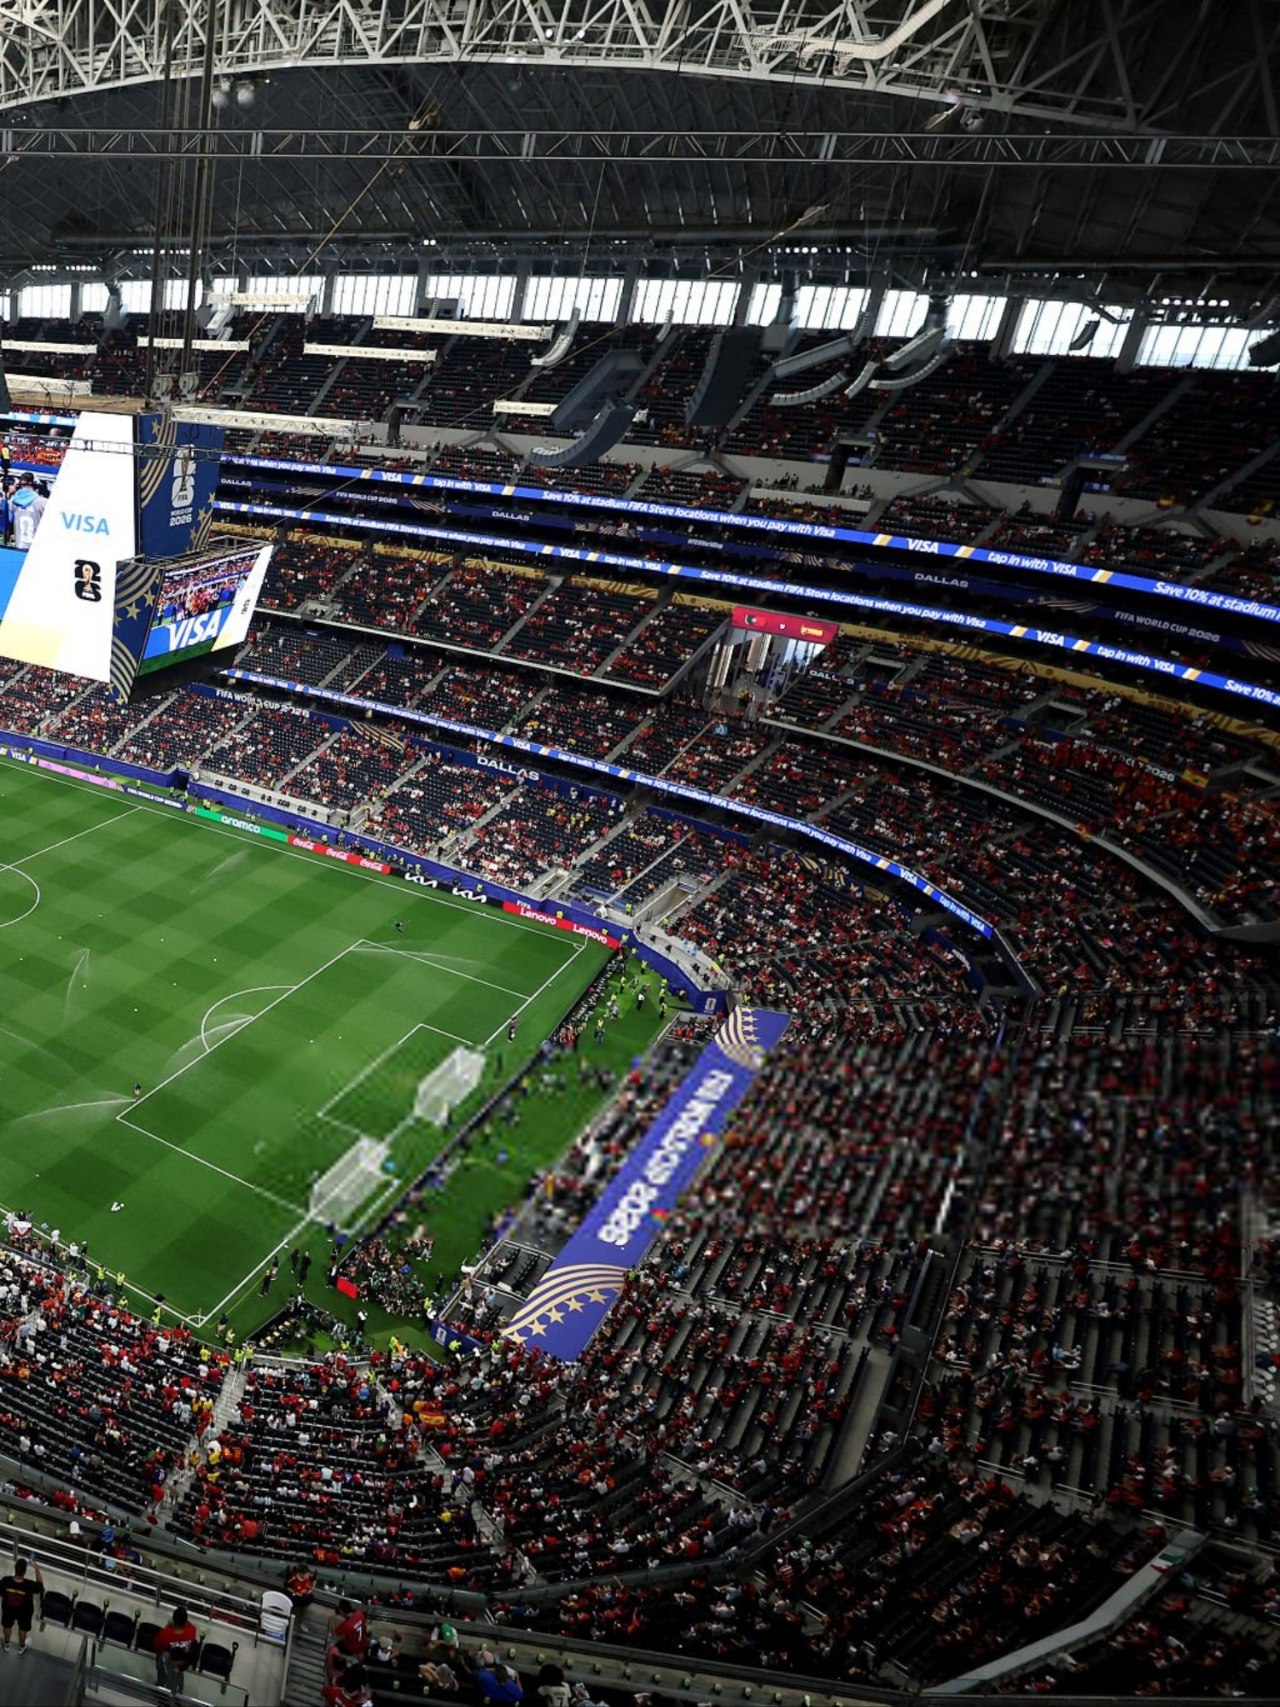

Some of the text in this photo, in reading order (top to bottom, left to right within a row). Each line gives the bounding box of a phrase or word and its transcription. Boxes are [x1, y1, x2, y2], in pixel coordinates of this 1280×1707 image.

[382, 472, 402, 483] VISA
[433, 478, 446, 488] tap
[455, 482, 472, 491] with
[474, 484, 492, 493] VISA
[60, 512, 110, 536] VISA
[170, 514, 193, 527] 2026
[492, 511, 530, 521] DALLAS
[543, 491, 836, 538] Save 10% at stadium FIFA Store locations when you pay with Visa
[560, 548, 580, 559] VISA
[907, 539, 939, 554] VISA
[605, 556, 618, 565] tap
[626, 559, 643, 568] with
[644, 561, 661, 571] VISA
[988, 552, 1077, 576] tap in with VISA
[914, 573, 969, 588] DALLAS
[701, 571, 986, 628] Save 10% at stadium FIFA Store locations when you pay with Visa
[1154, 582, 1277, 619] Save 10% at stadium
[165, 609, 222, 651] VISA
[1115, 611, 1221, 643] FIFA WORLD CUP 2026
[1036, 631, 1064, 647] VISA
[1097, 647, 1175, 674] tap in with VISA
[810, 670, 855, 685] DALLS
[216, 690, 233, 700] FIFA
[264, 700, 280, 710] CUP
[1224, 680, 1275, 702] Save 10%
[512, 738, 531, 751] VISA
[10, 749, 27, 762] VISA
[477, 756, 540, 781] DALLAS
[221, 815, 261, 834] aramco
[635, 775, 654, 785] Save
[654, 780, 669, 790] 10%
[678, 788, 710, 802] stadium
[710, 796, 727, 808] FIFA
[728, 802, 750, 814] Store
[750, 809, 788, 827] locations
[789, 821, 811, 834] when
[810, 830, 825, 840] you
[824, 836, 840, 847] pay
[839, 842, 856, 855] with
[856, 849, 872, 862] Visa
[900, 867, 918, 886] VISA
[520, 908, 557, 926] Lenovo
[573, 924, 608, 944] Lenovo
